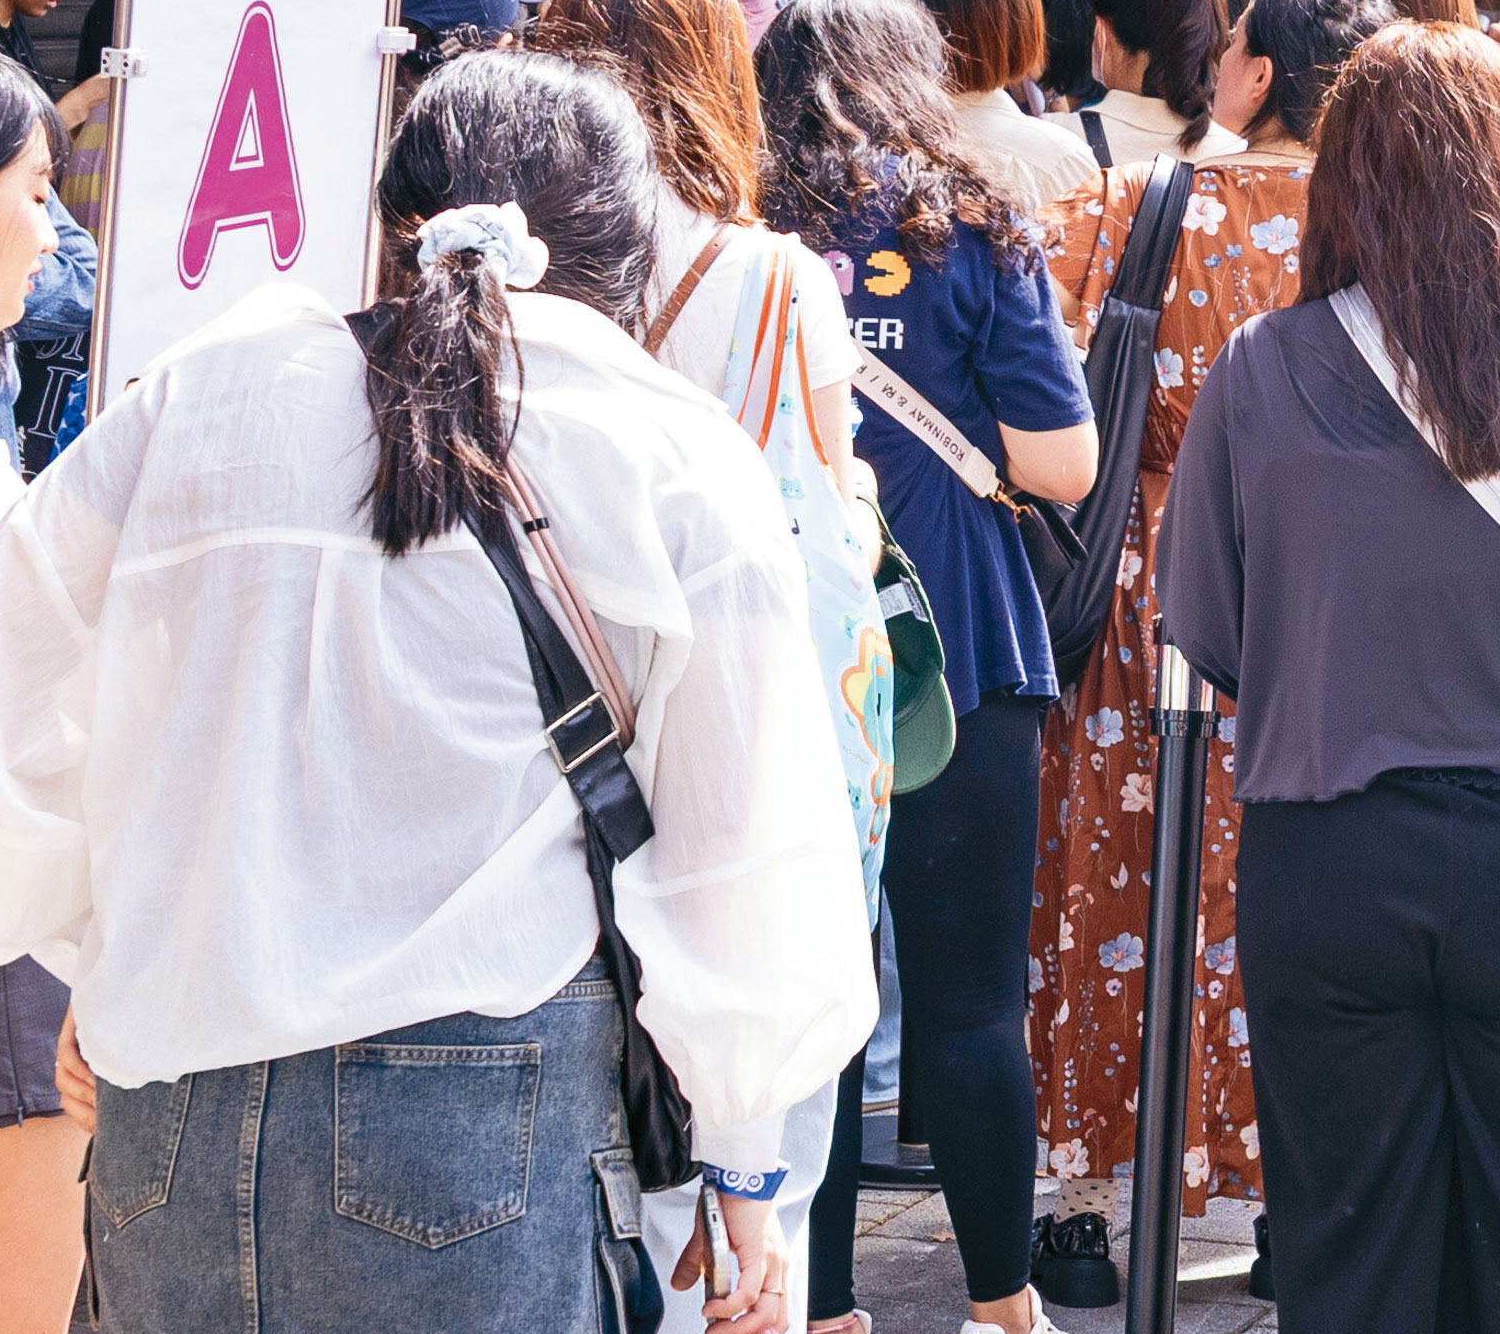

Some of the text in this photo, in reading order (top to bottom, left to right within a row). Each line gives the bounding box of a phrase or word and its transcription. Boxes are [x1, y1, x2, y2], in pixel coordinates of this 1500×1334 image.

[177, 0, 306, 289] A
[896, 393, 907, 409] &
[908, 405, 965, 463] ROBINMAY
